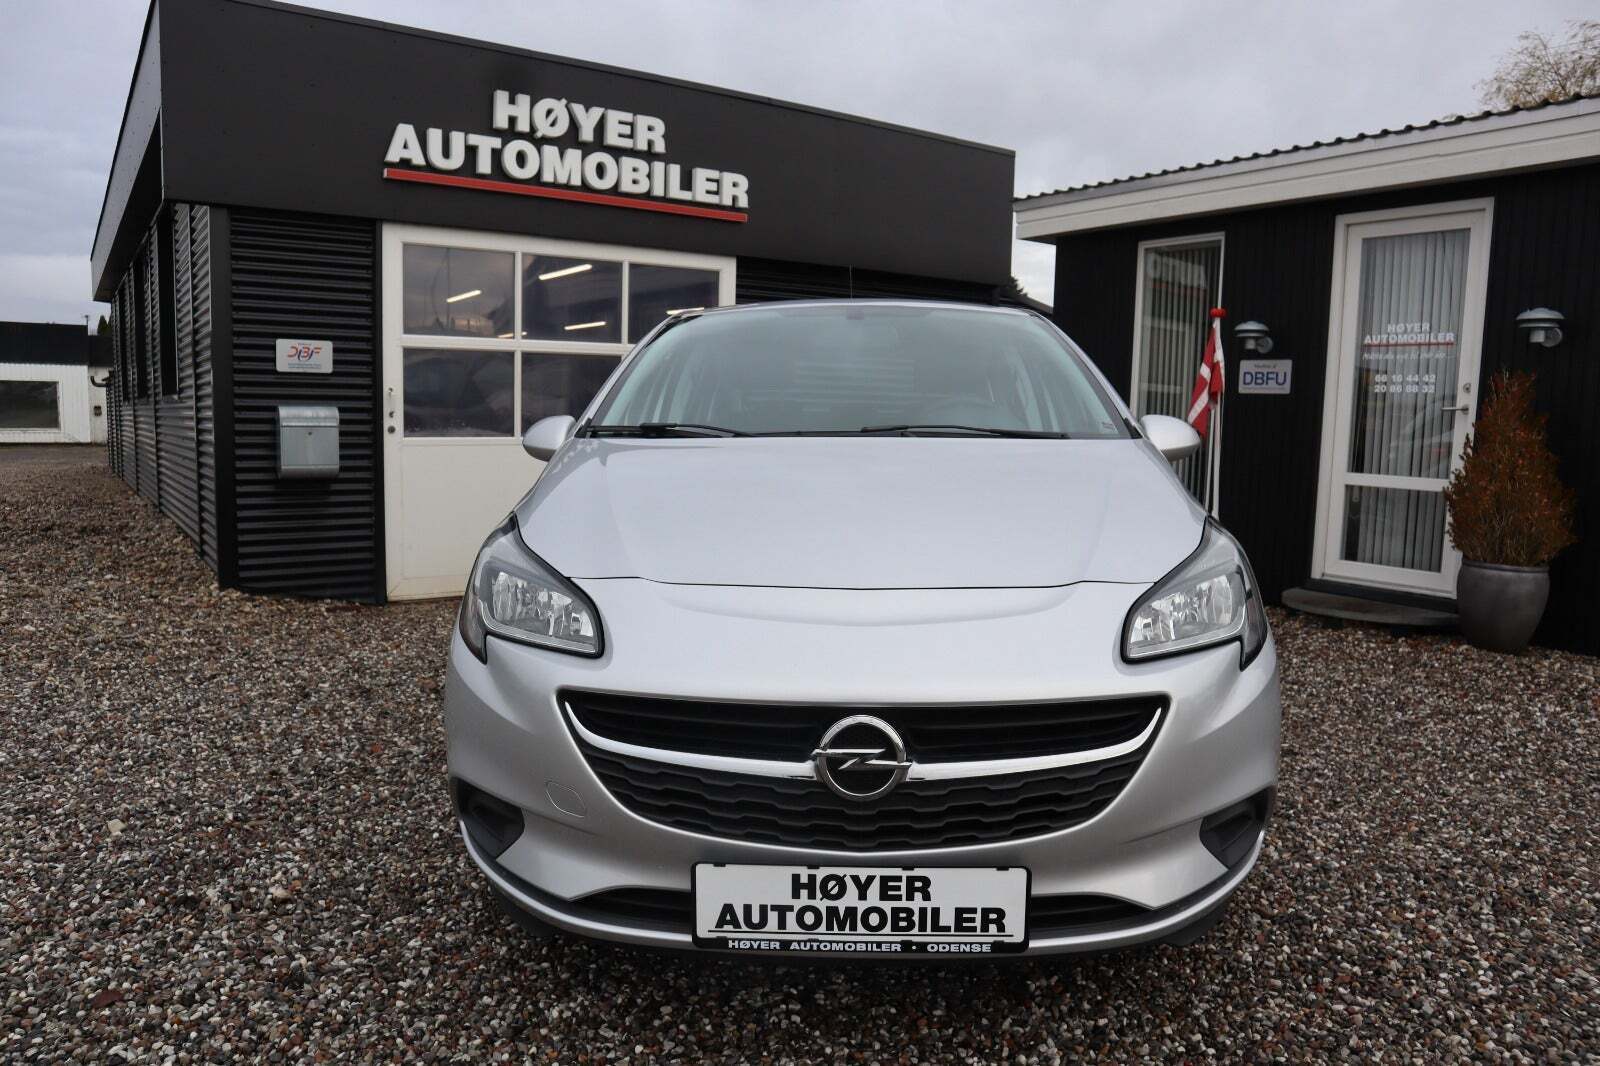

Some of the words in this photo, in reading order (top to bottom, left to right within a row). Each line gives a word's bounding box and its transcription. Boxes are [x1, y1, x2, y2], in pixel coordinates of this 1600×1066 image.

[492, 89, 667, 155] HØYER
[384, 123, 750, 208] AUTOMOBILER
[1363, 332, 1455, 345] AUTOMOBILER
[1242, 371, 1287, 386] DBFU
[791, 873, 932, 902] HØYER
[714, 903, 1007, 933] AUTOMOBILER
[728, 939, 781, 950] HØYER
[789, 941, 902, 952] AUTOMOBILER
[927, 943, 992, 953] ODENSE
